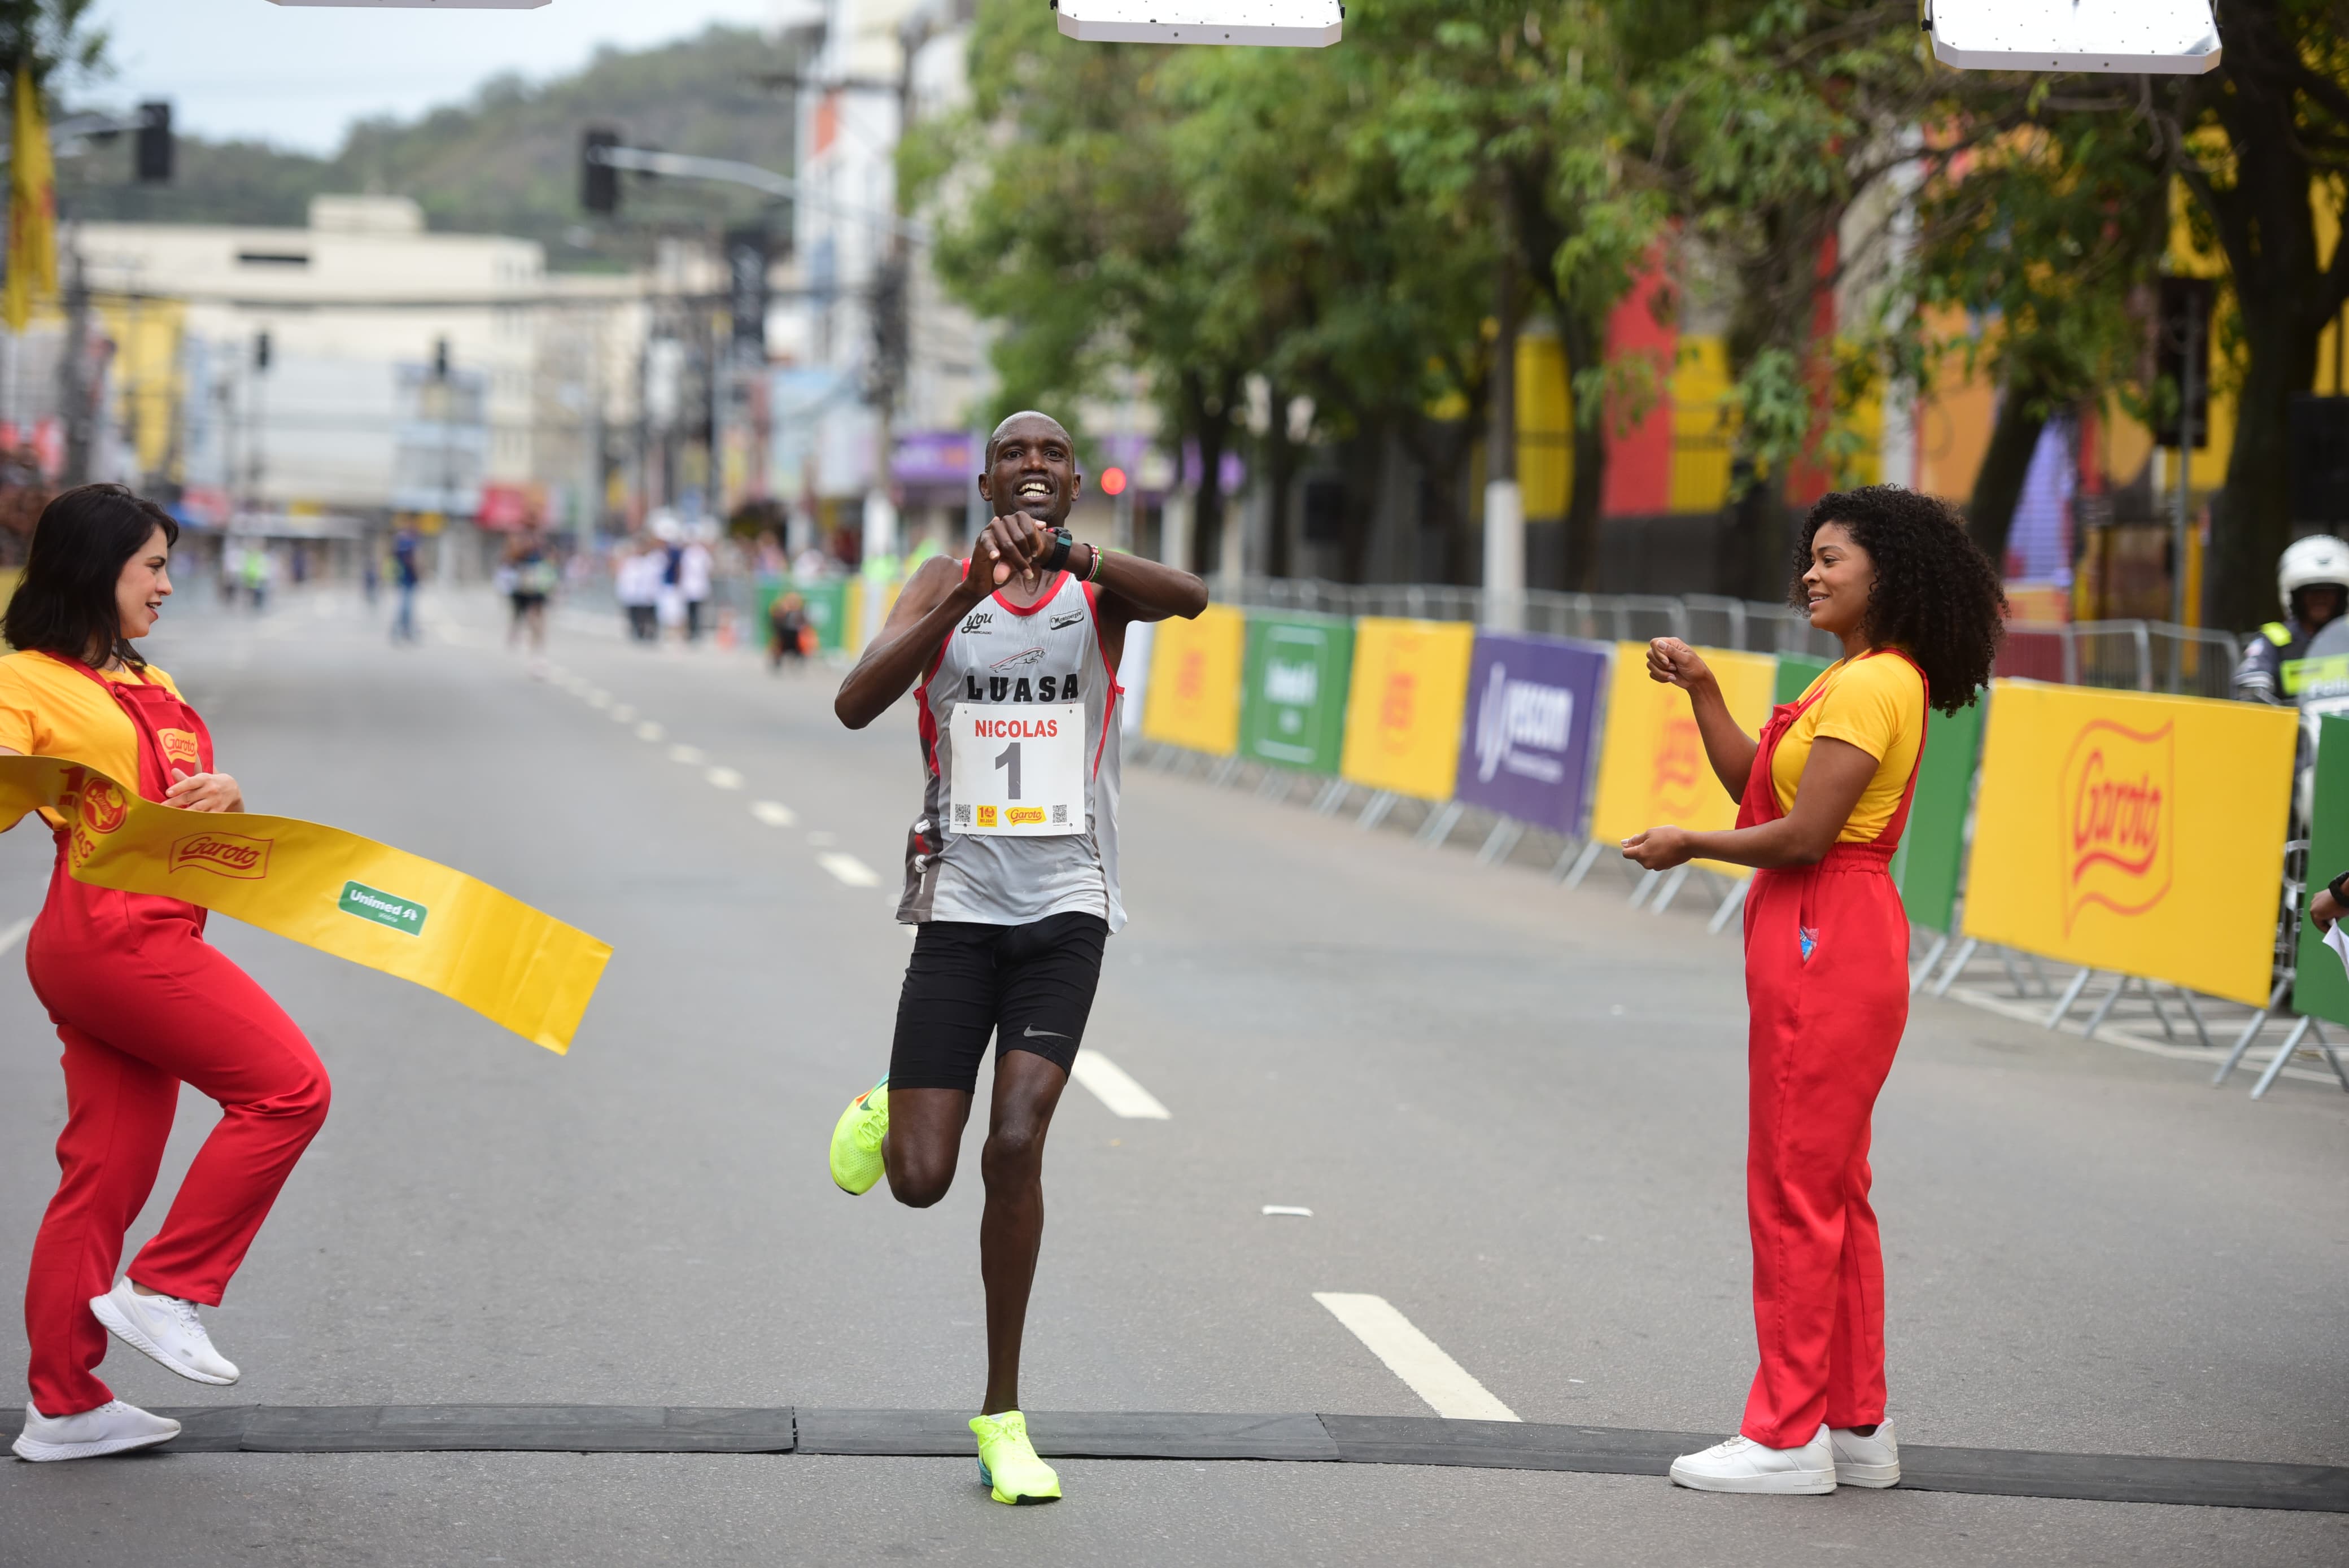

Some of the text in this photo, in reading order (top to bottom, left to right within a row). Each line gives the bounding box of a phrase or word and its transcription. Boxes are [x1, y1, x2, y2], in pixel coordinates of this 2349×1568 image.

[961, 613, 993, 634] you
[967, 674, 1079, 702] LUASA
[975, 719, 1058, 738] NICOLAS
[163, 733, 195, 753] Garoto
[994, 742, 1021, 800] 1
[2073, 747, 2163, 854] Garoto
[1010, 809, 1042, 819] Garoto
[180, 836, 262, 864] Garoto
[350, 889, 403, 915] Unimed
